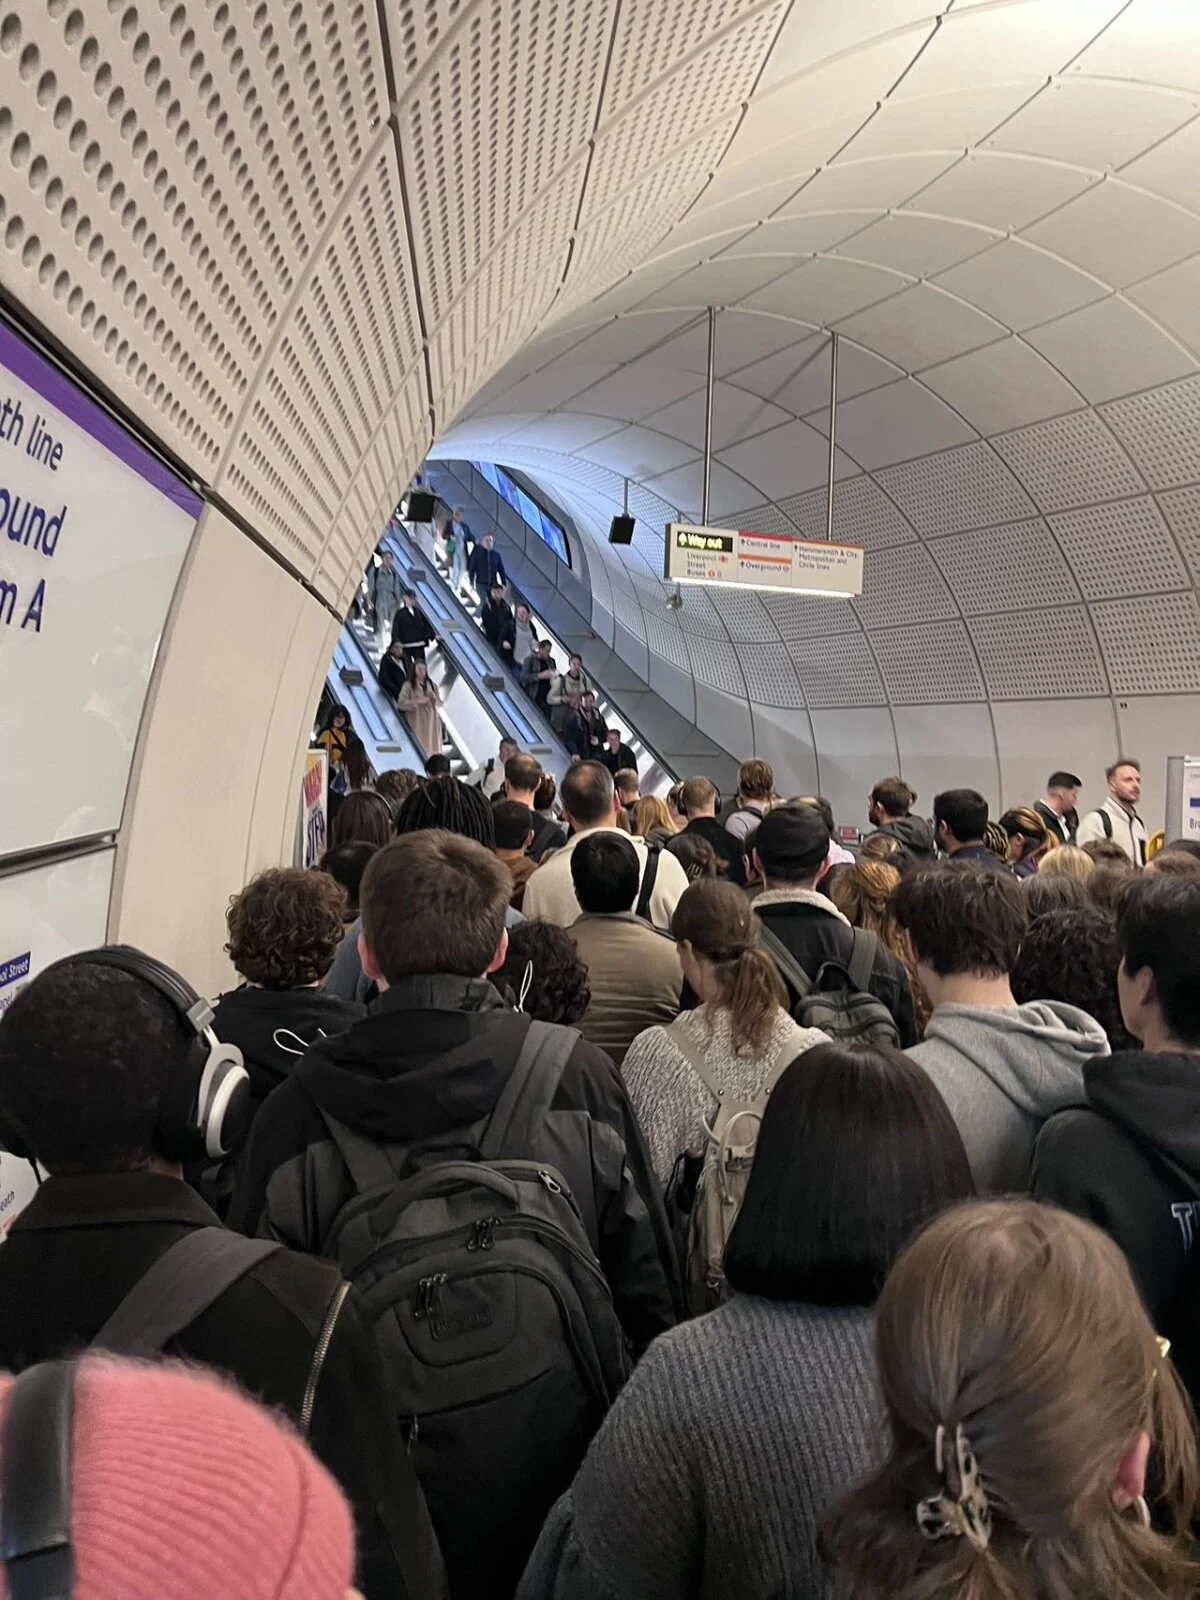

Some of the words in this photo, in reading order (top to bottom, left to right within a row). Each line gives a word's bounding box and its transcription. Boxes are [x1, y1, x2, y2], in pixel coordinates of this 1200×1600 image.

[0, 397, 25, 447] th
[26, 413, 63, 472] line
[687, 533, 706, 549] Way
[707, 537, 723, 549] out
[20, 579, 46, 633] A
[8, 958, 28, 979] Street
